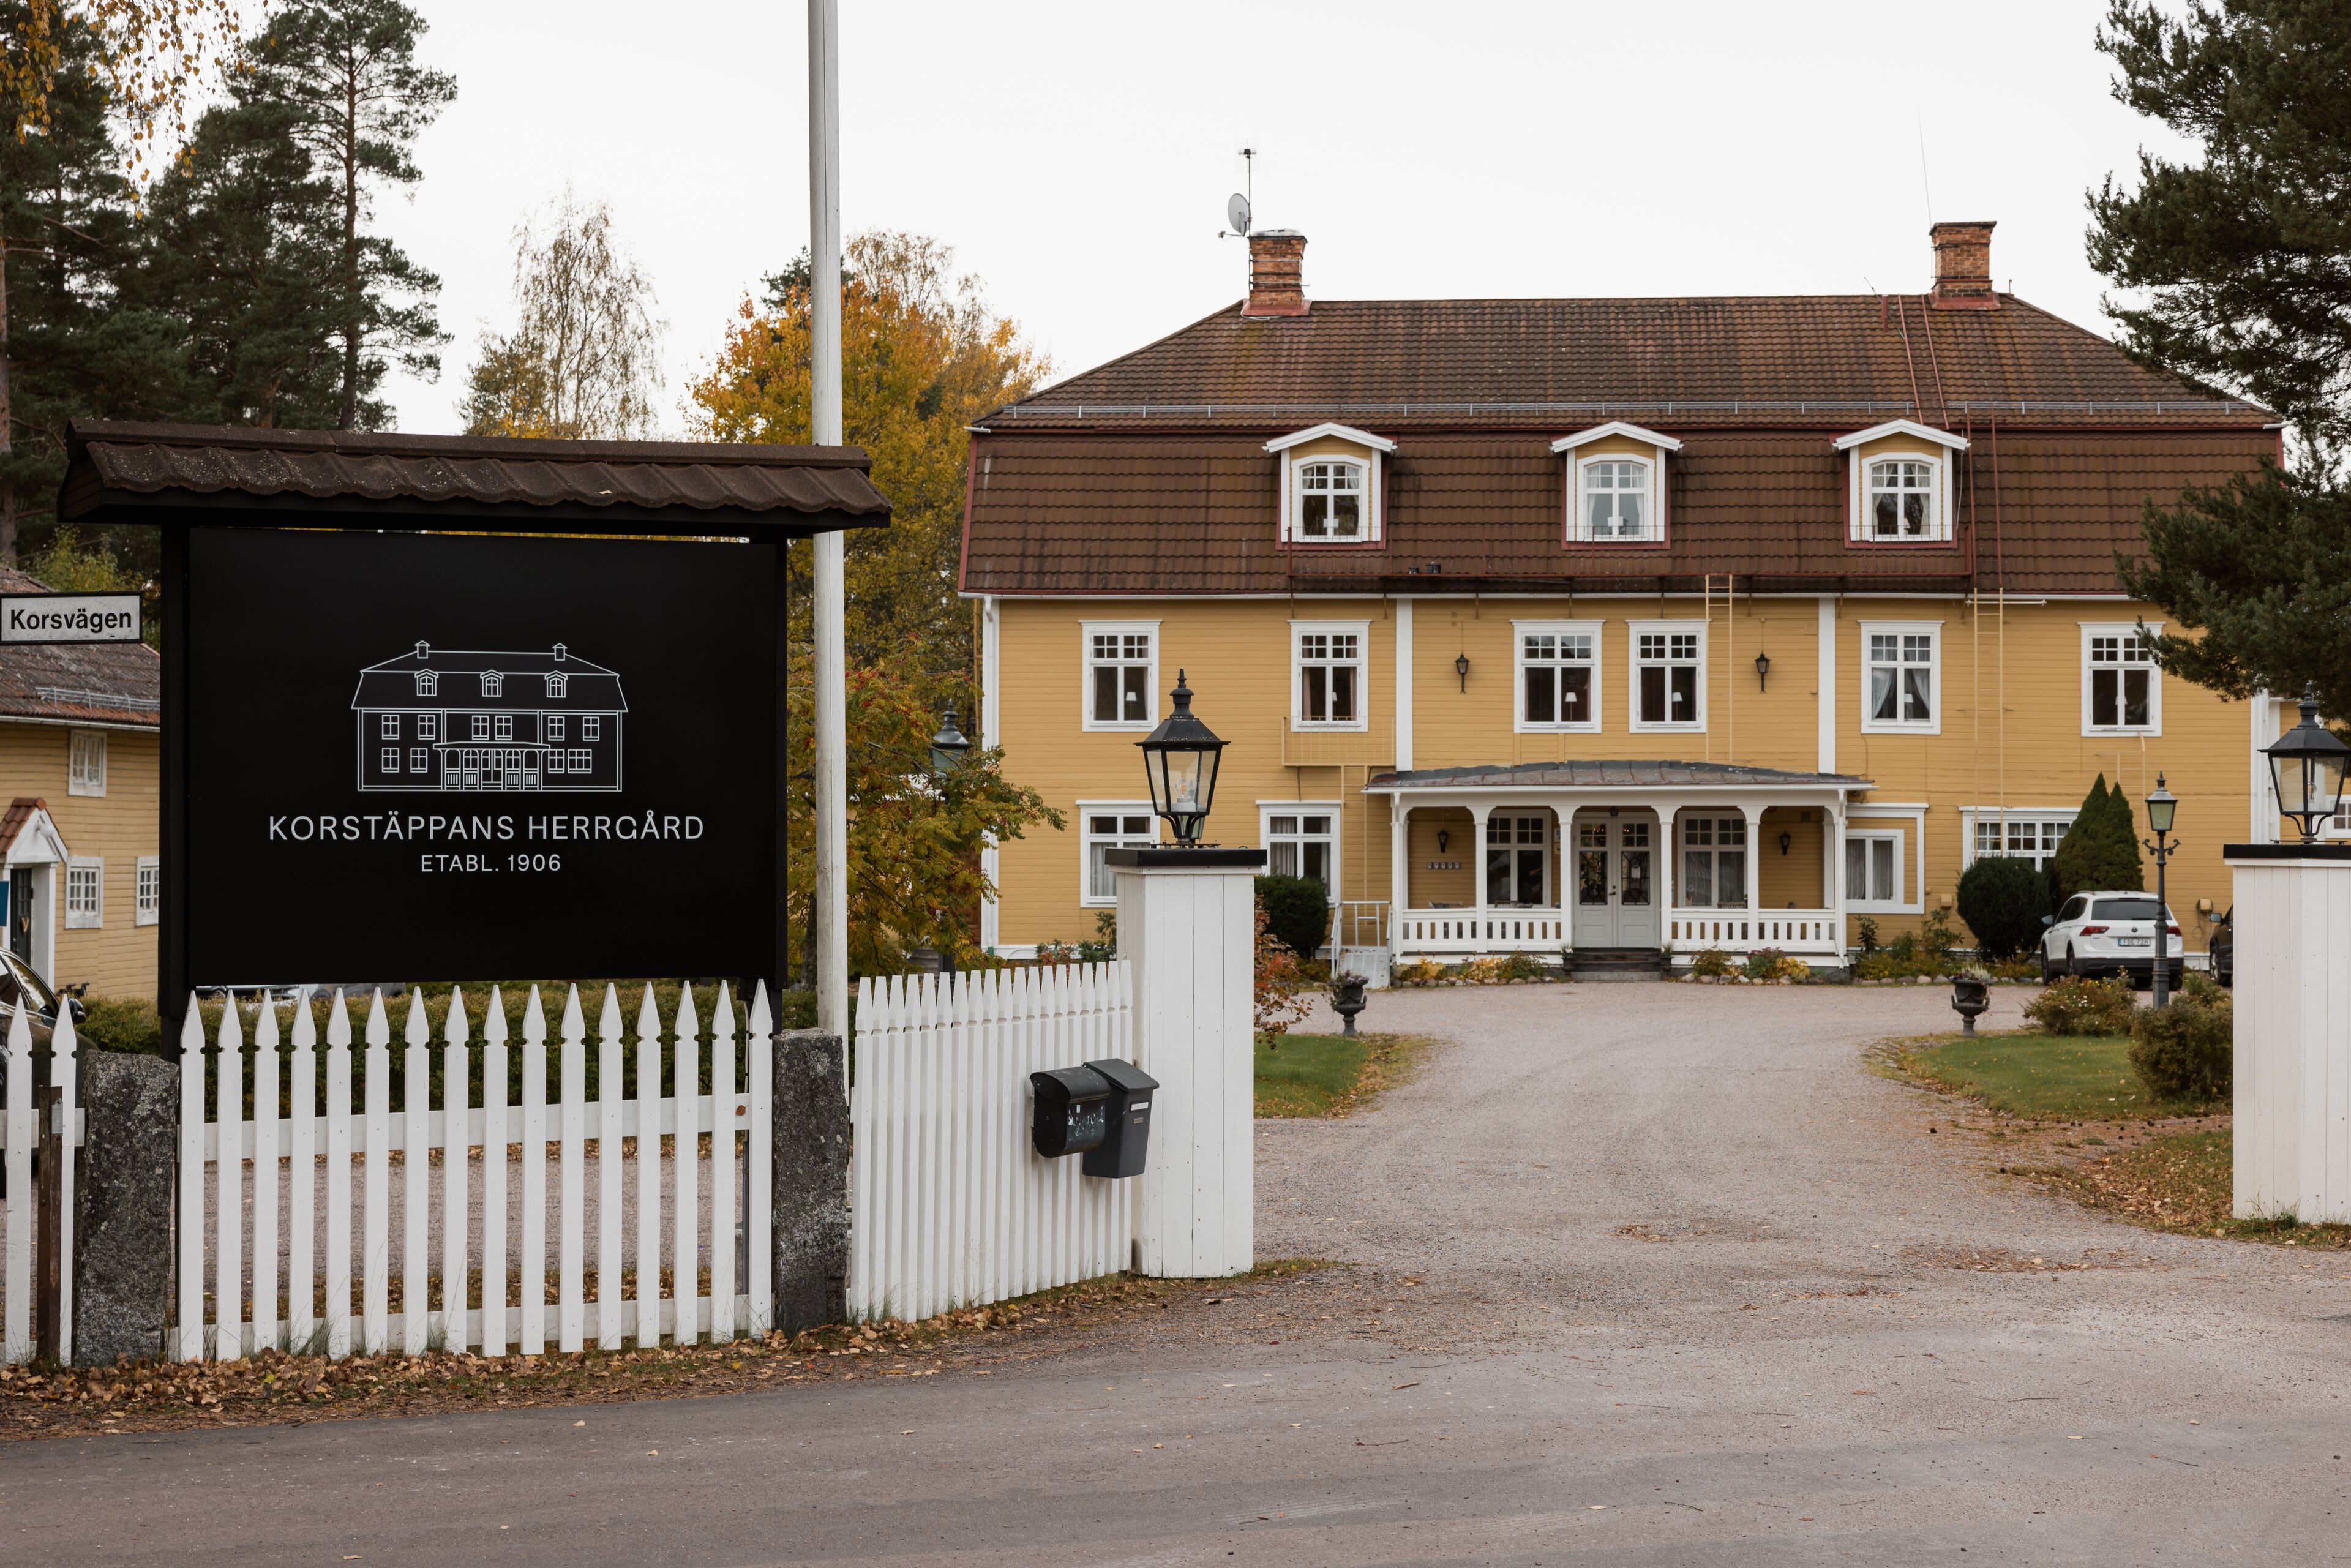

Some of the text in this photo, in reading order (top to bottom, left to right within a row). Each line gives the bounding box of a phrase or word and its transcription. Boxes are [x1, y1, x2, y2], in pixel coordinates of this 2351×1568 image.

[10, 608, 132, 634] Korsvägen
[269, 809, 703, 841] KORSTÄPPANS HERRGÅRD
[421, 853, 561, 872] ETABL. 1906
